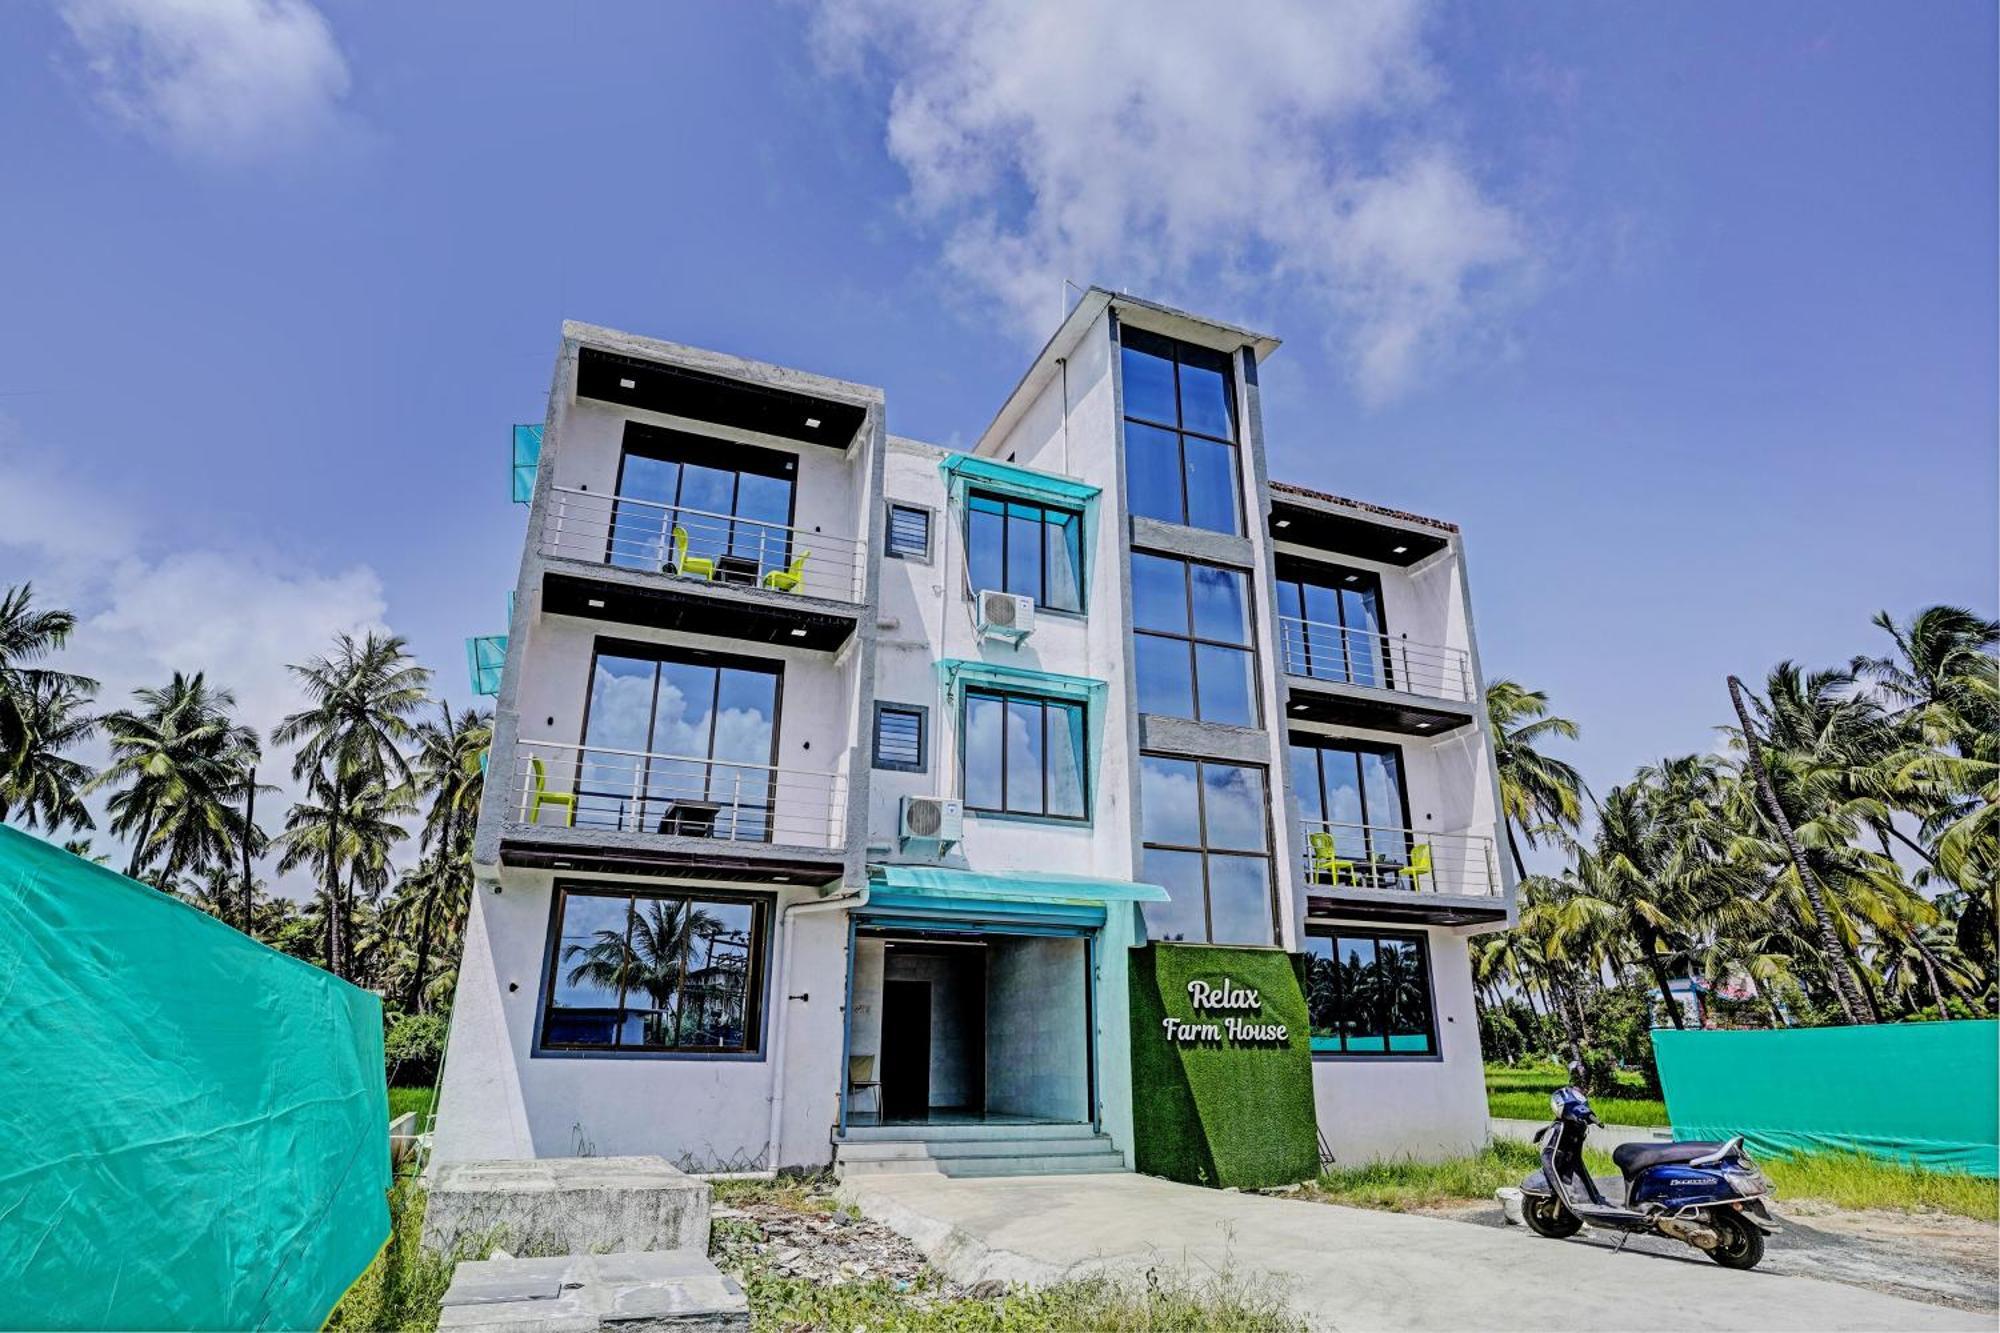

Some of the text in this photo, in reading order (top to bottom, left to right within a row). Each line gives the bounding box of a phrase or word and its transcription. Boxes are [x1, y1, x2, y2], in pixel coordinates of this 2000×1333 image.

[1187, 978, 1261, 1009] Relax
[1162, 1018, 1288, 1041] Farm House
